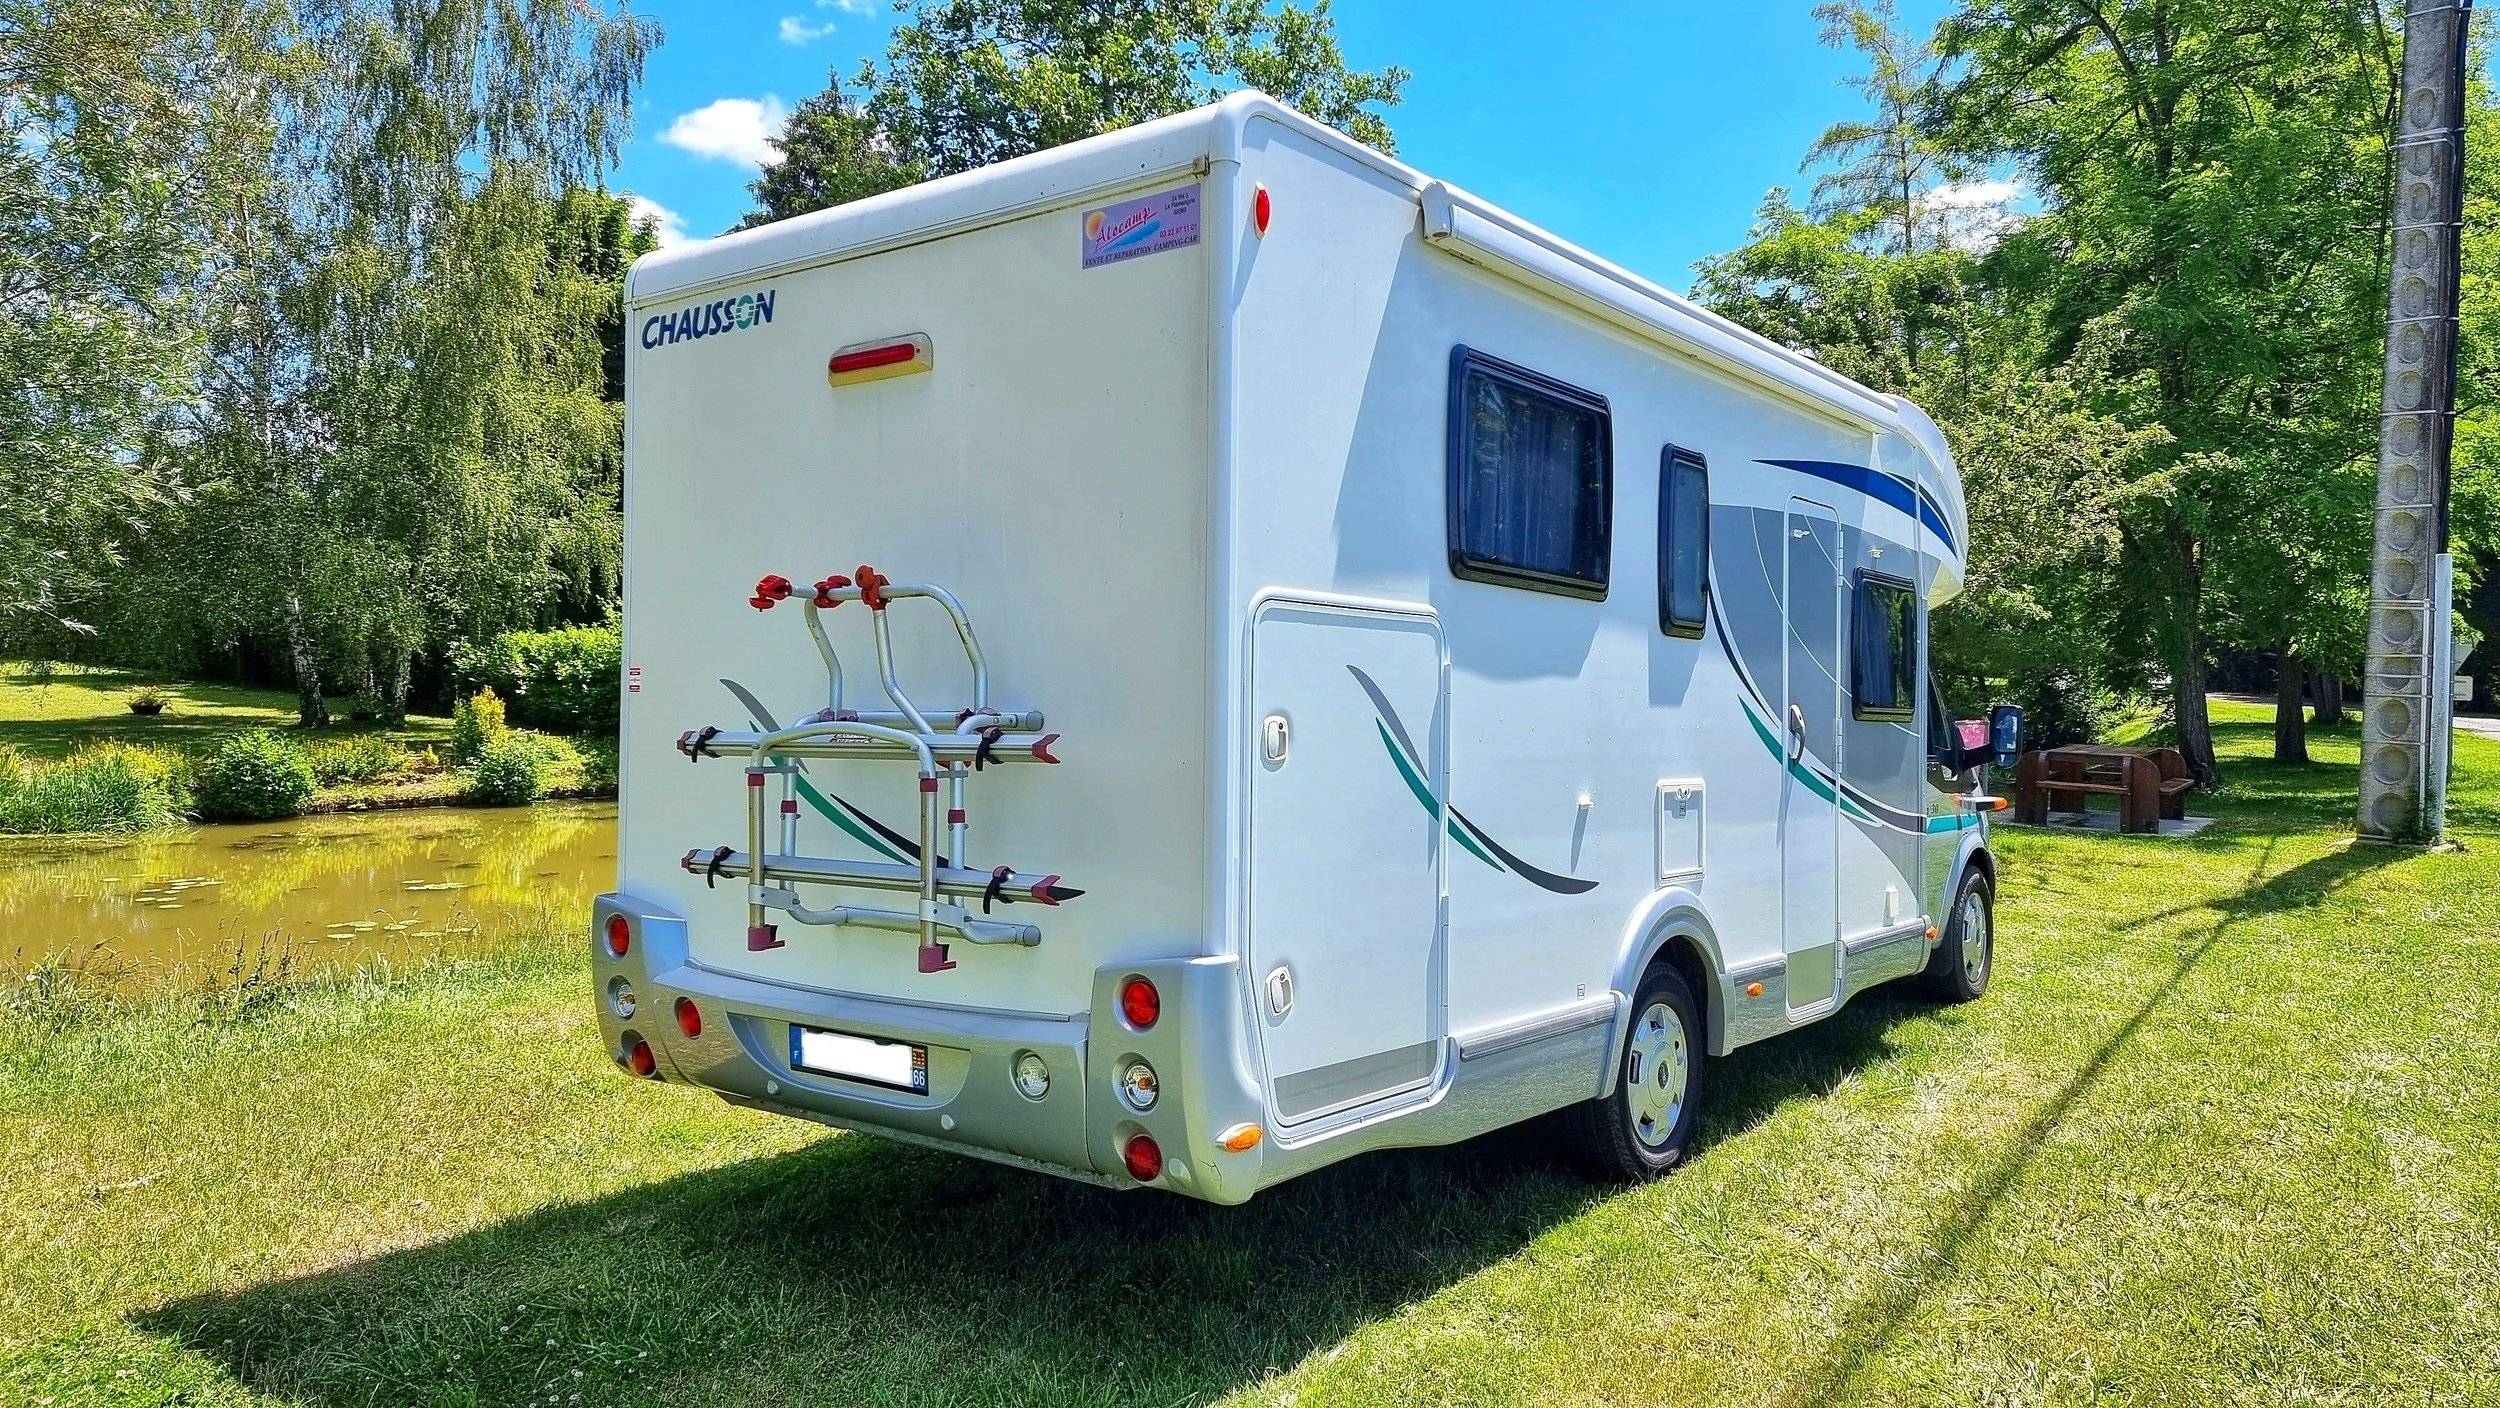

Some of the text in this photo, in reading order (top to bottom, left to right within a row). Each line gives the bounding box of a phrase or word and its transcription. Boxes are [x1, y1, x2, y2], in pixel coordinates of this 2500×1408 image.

[641, 289, 776, 350] CHAUSSON
[793, 1050, 799, 1060] F
[913, 1069, 926, 1087] 66
